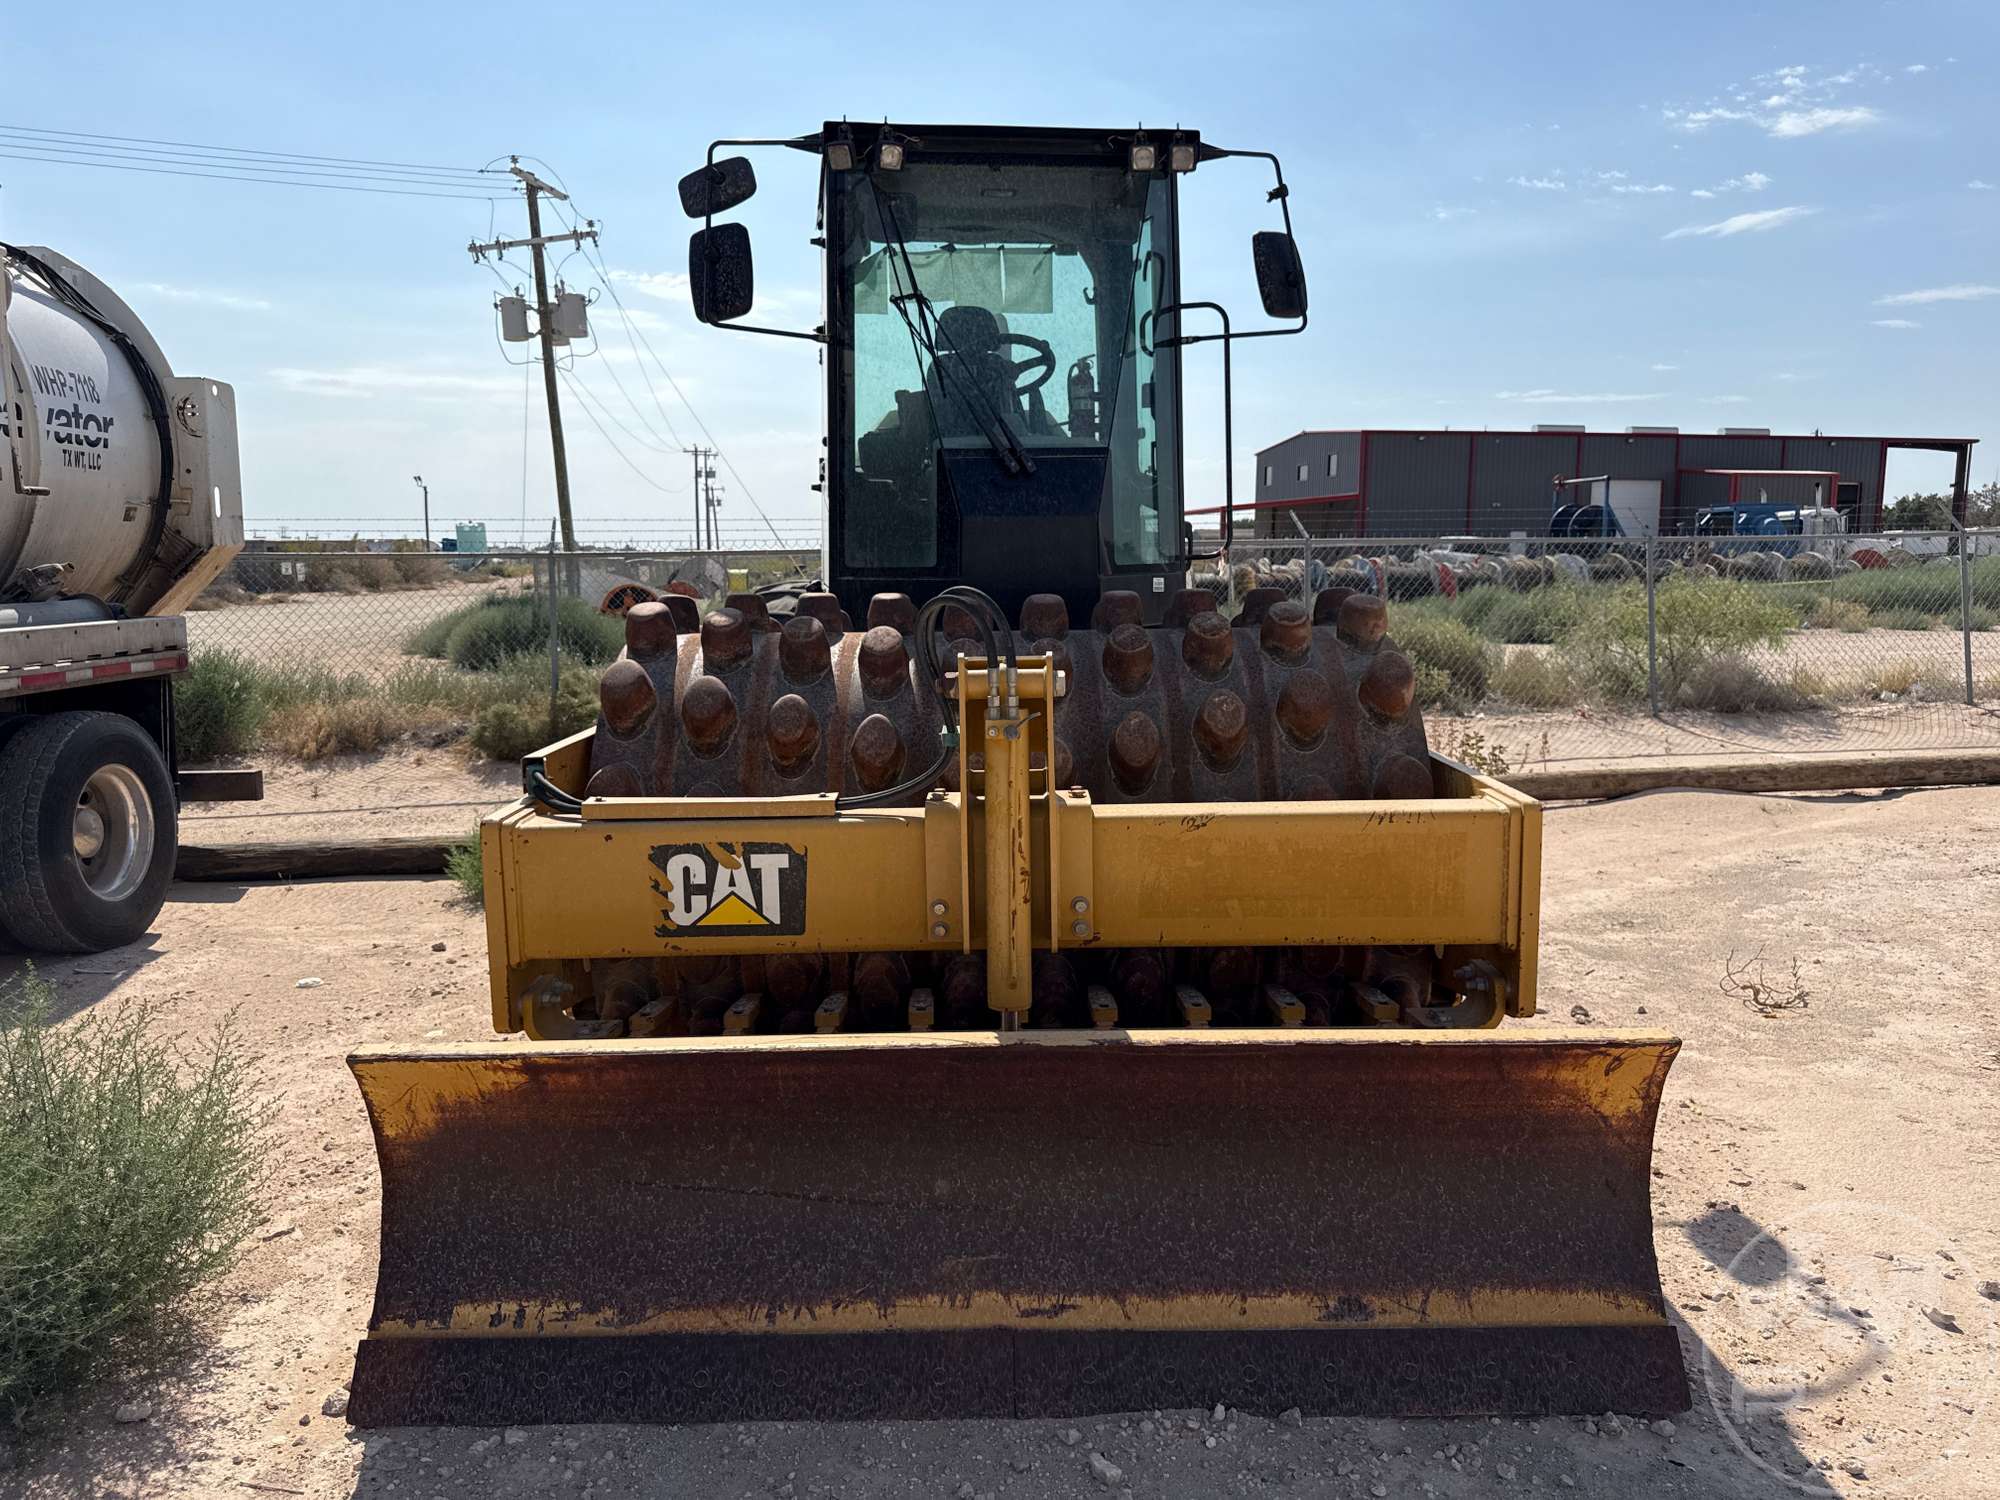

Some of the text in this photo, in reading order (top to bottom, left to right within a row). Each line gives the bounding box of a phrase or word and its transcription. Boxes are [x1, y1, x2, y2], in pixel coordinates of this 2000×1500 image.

[31, 364, 101, 404] WHP-7118
[62, 449, 72, 467] TX
[88, 453, 101, 471] LLC
[666, 853, 789, 926] CAT
